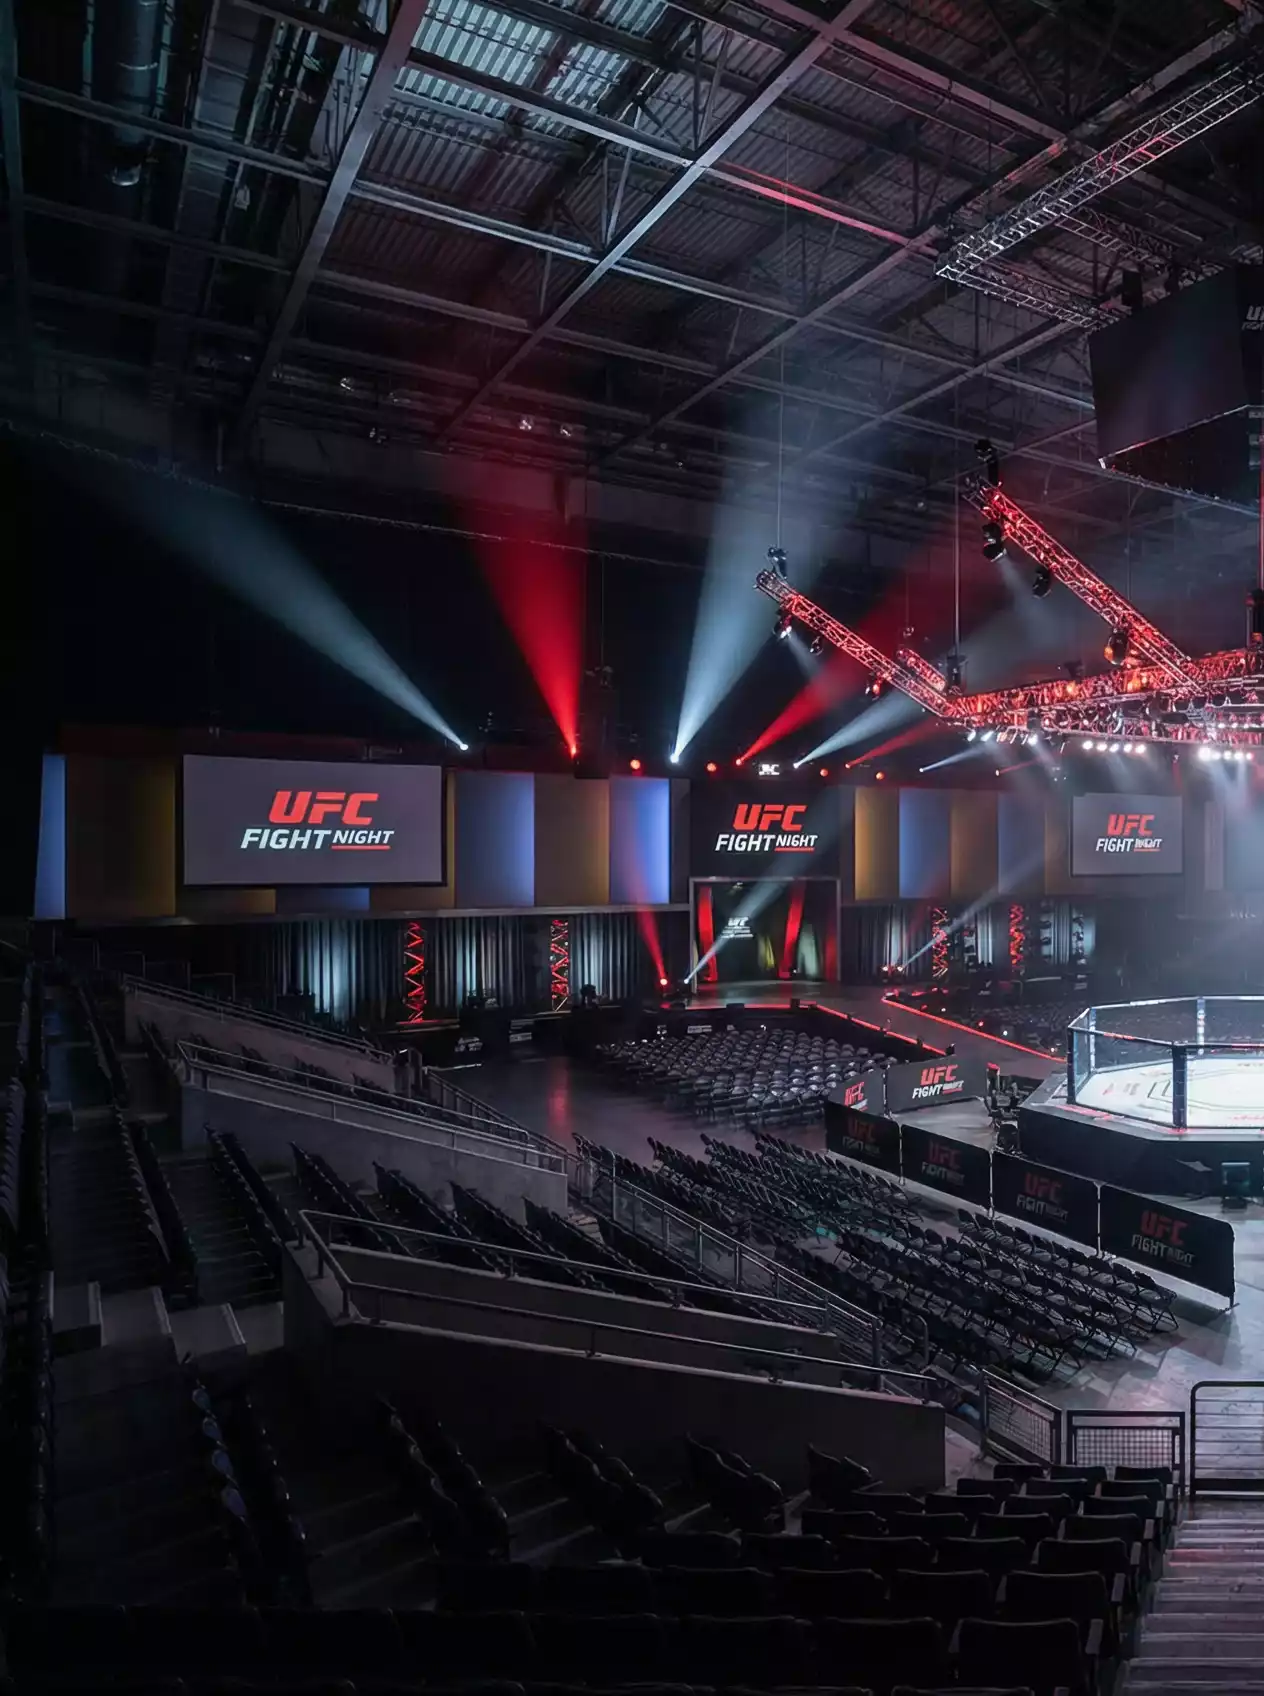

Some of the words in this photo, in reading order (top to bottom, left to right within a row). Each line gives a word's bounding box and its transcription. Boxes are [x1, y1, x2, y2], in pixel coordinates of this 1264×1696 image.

[268, 790, 379, 826] UFC
[732, 803, 808, 831] UFC
[1107, 813, 1155, 836] UFC
[240, 828, 332, 850] FIGHT
[332, 829, 395, 845] NIGHT
[714, 834, 776, 852] FIGHT
[775, 834, 819, 847] NIGHT
[1095, 838, 1134, 853] FIGHT
[920, 1064, 958, 1086] UFC
[1024, 1171, 1063, 1203] UFC
[1140, 1210, 1190, 1246] UFC
